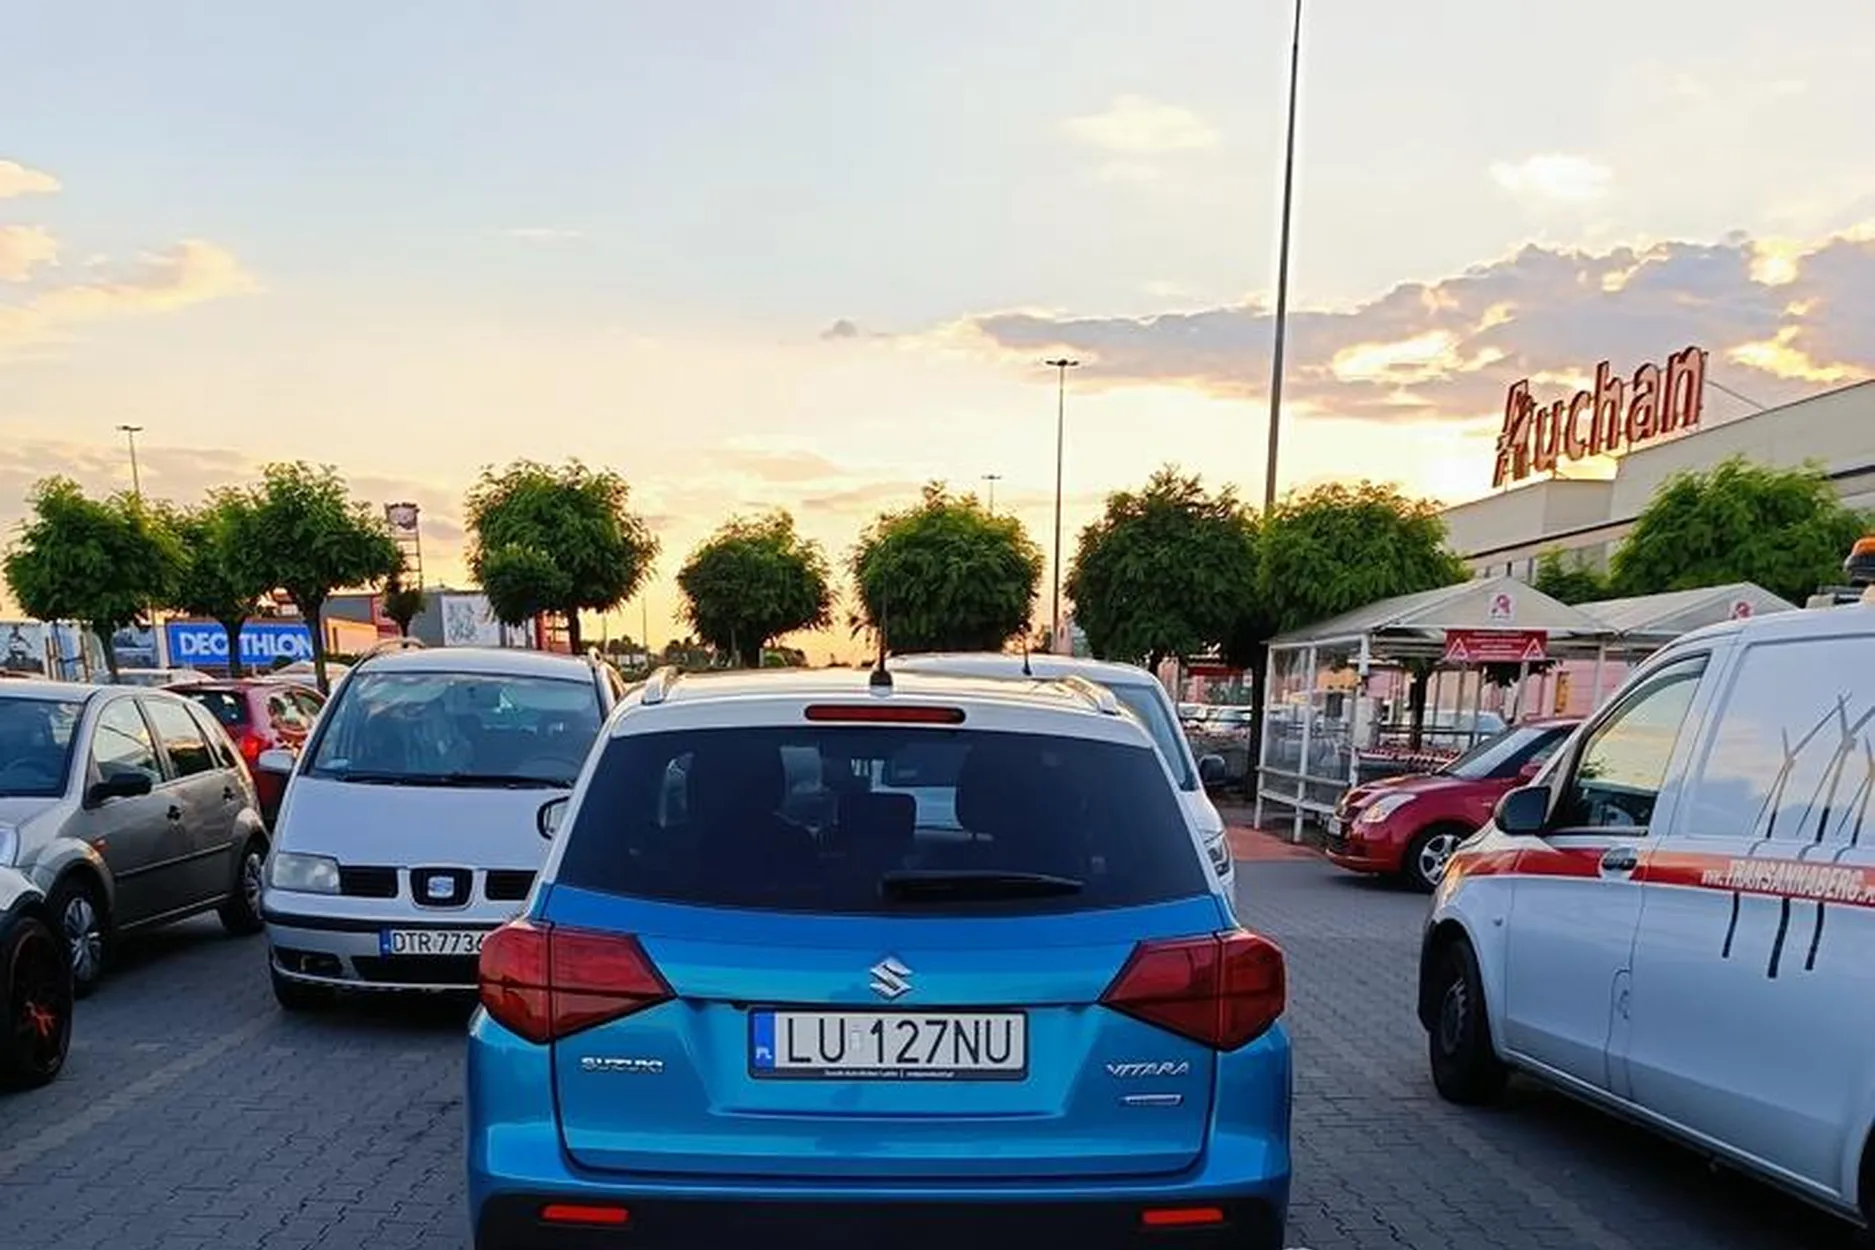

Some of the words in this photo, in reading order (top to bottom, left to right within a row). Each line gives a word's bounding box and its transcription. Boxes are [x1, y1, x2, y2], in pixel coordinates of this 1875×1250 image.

[1492, 346, 1708, 488] Auchan
[179, 632, 314, 658] DECTHLON
[392, 932, 431, 952] DTR
[787, 1018, 845, 1063] LU
[870, 1019, 1011, 1064] 127NU
[1106, 1062, 1190, 1077] VITARA
